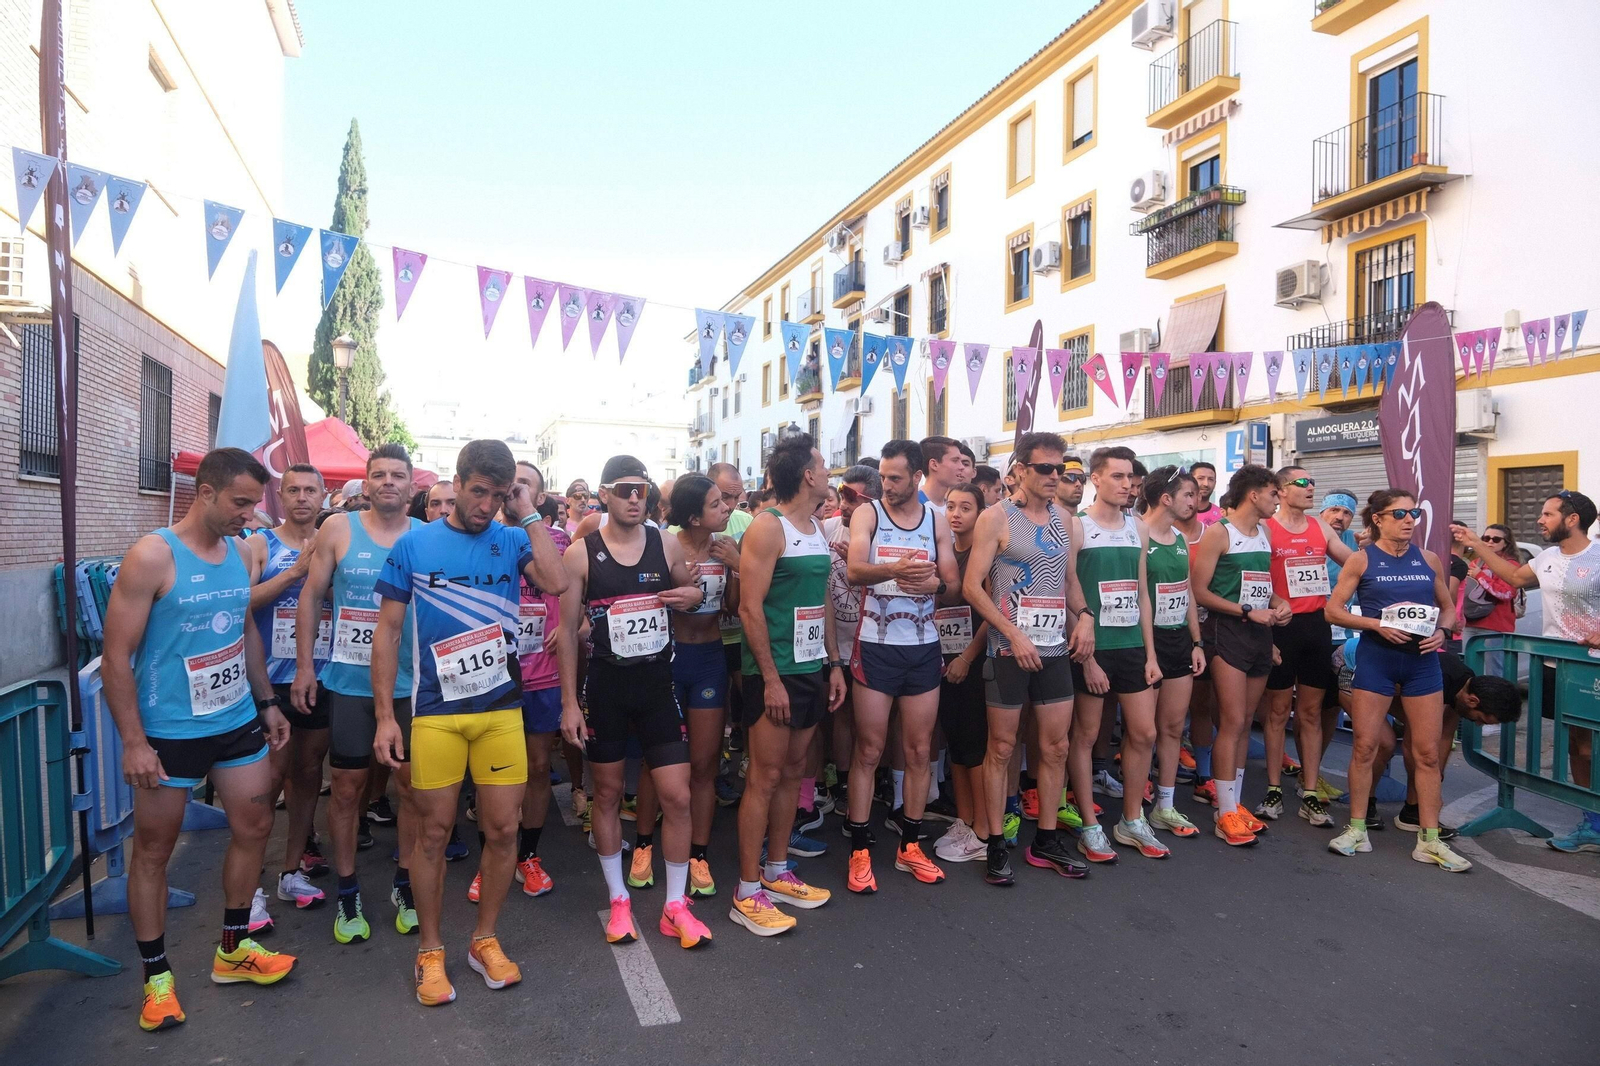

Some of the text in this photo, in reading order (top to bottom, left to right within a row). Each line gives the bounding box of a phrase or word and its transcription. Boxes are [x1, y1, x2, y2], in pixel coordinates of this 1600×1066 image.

[1307, 420, 1374, 435] ALMOGUERA 2.0
[1253, 425, 1264, 445] L
[1297, 570, 1320, 581] 251
[1376, 574, 1431, 582] TROTASIERRA
[1250, 586, 1268, 598] 289
[1114, 596, 1133, 609] 278
[1168, 595, 1186, 610] 274
[1398, 607, 1427, 619] 663
[626, 616, 658, 636] 224
[1032, 614, 1058, 628] 177
[808, 625, 820, 640] 80
[940, 623, 961, 637] 642
[443, 638, 461, 650] CARRERA
[197, 654, 218, 664] CARRERA
[457, 649, 494, 675] 116
[210, 663, 240, 690] 283
